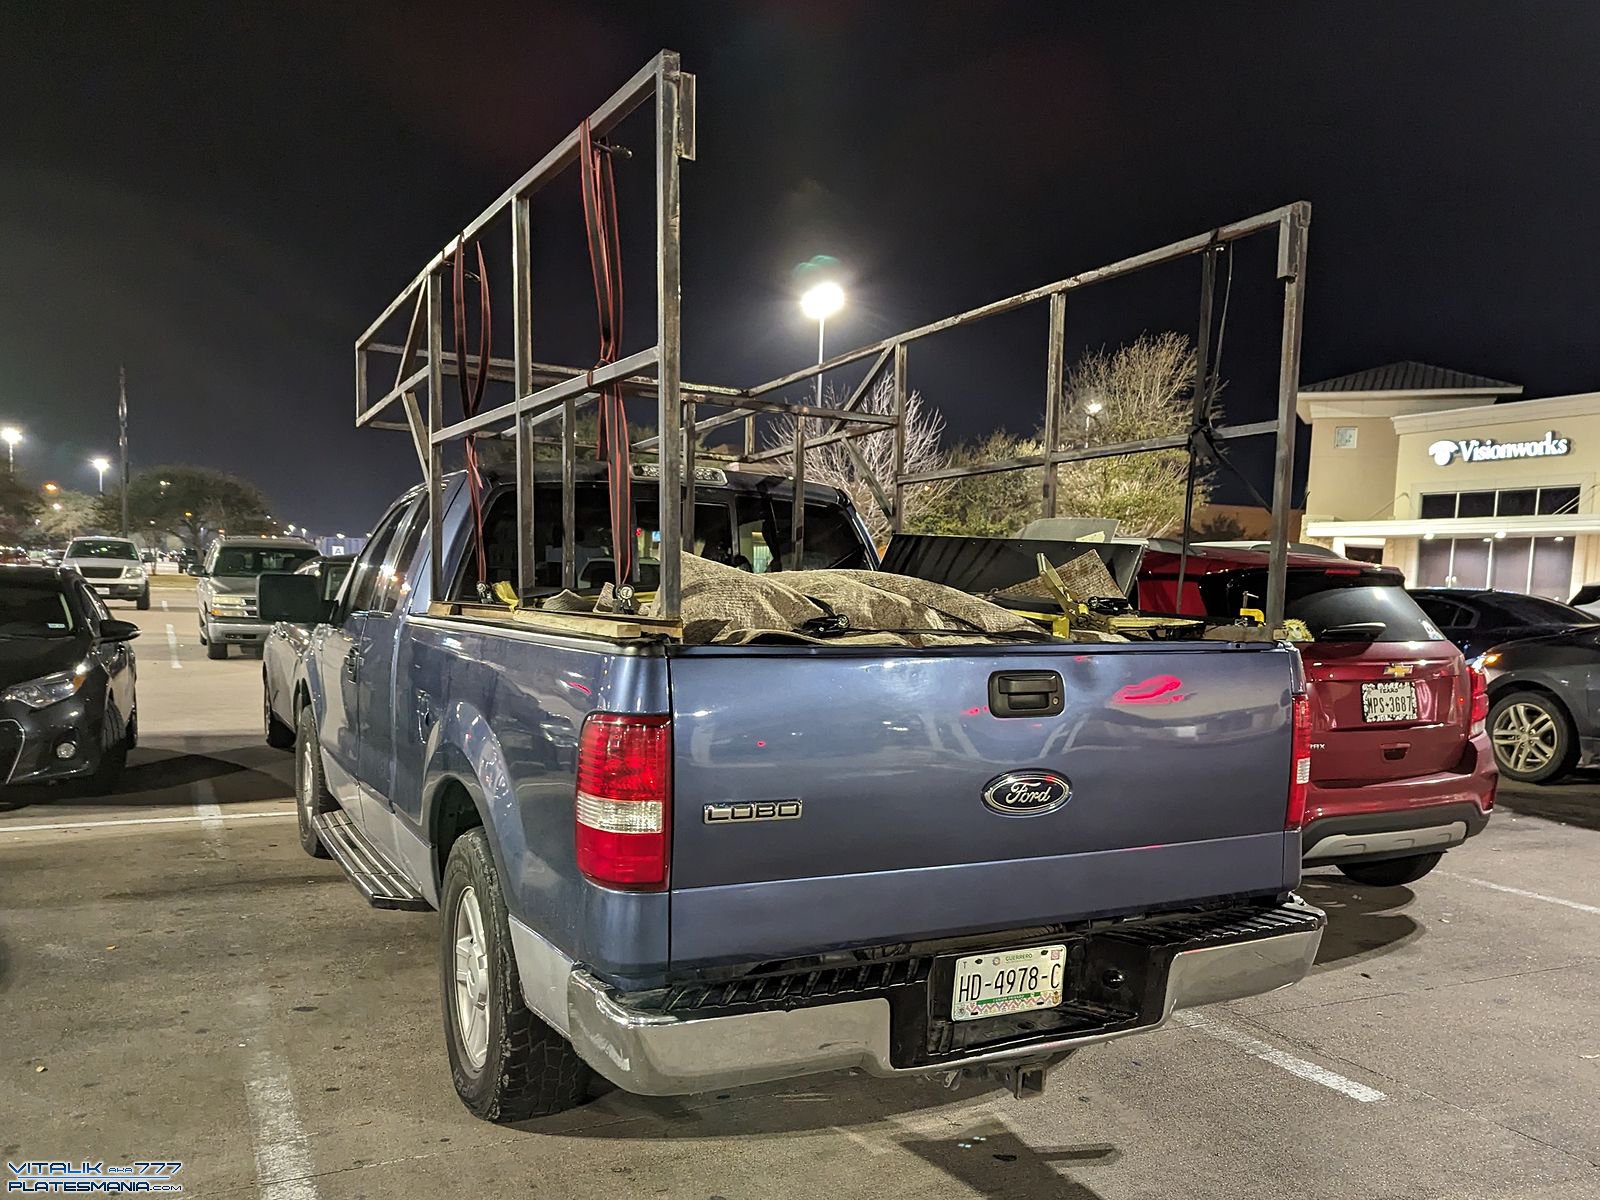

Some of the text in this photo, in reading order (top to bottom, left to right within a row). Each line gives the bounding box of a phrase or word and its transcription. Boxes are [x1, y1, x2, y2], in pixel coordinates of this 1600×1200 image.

[1458, 431, 1568, 461] Visionworks
[1005, 782, 1052, 804] Ford
[707, 802, 800, 821] LOBO
[1005, 953, 1033, 962] GUERRERO
[958, 963, 1061, 1003] HD-4978-C
